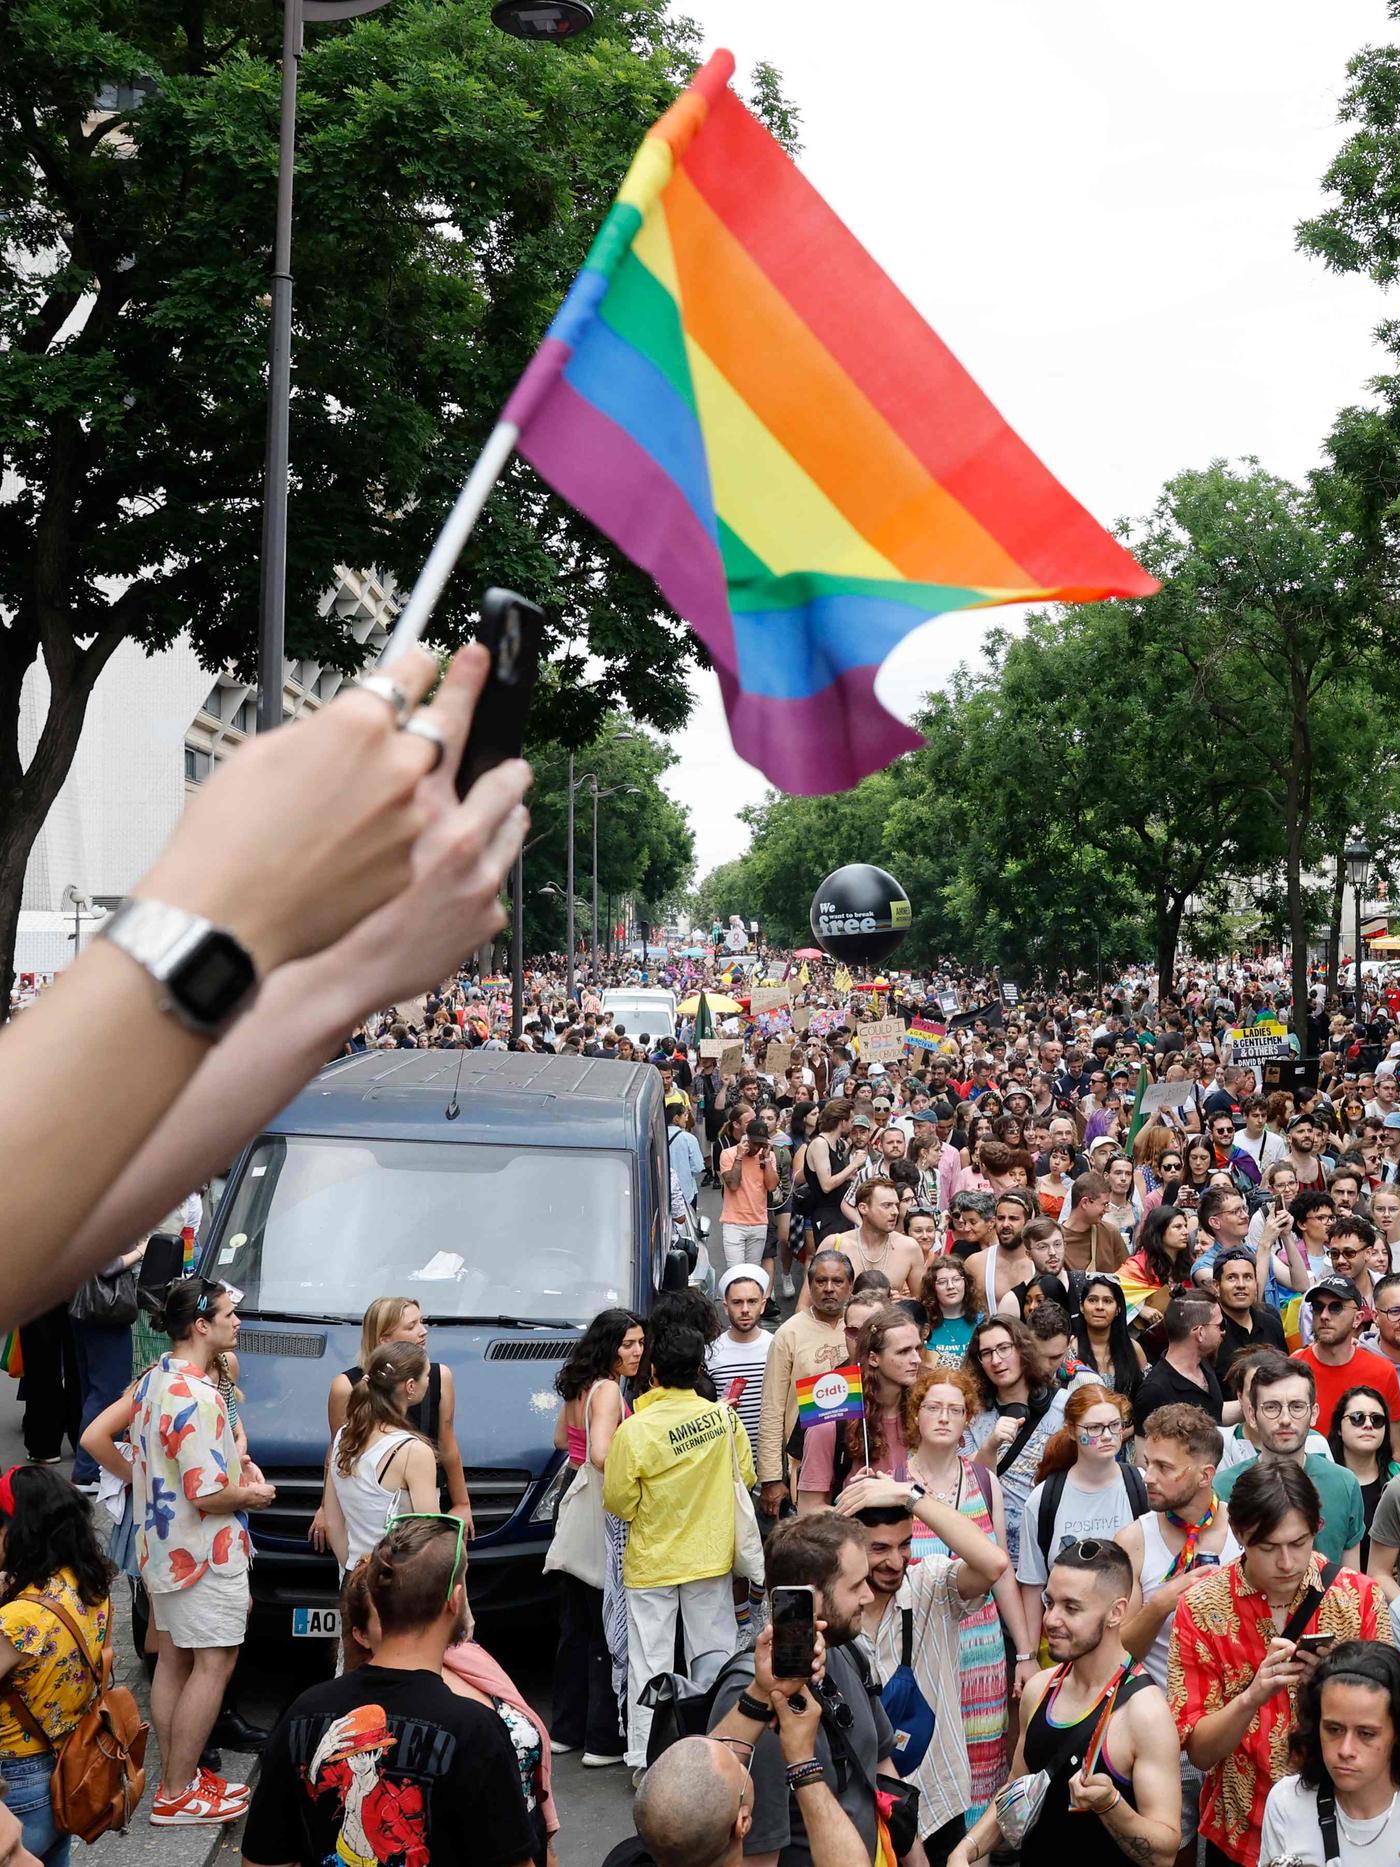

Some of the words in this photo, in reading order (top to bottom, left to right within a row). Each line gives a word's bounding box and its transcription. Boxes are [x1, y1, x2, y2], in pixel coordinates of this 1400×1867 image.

[820, 903, 836, 913] We
[819, 915, 876, 936] free
[860, 1023, 892, 1037] COULD
[1243, 1028, 1271, 1037] LADIES
[1233, 1040, 1239, 1048] &
[1240, 1036, 1282, 1047] GENTLEMEN
[1240, 1049, 1247, 1057] &
[1248, 1045, 1278, 1057] OTHERS
[1238, 1058, 1257, 1066] DAVID
[668, 1409, 723, 1445] AMNESTY
[673, 1426, 727, 1456] INTERNATIONAL
[1064, 1515, 1120, 1533] POSITIVE
[288, 1715, 457, 1776] WED
